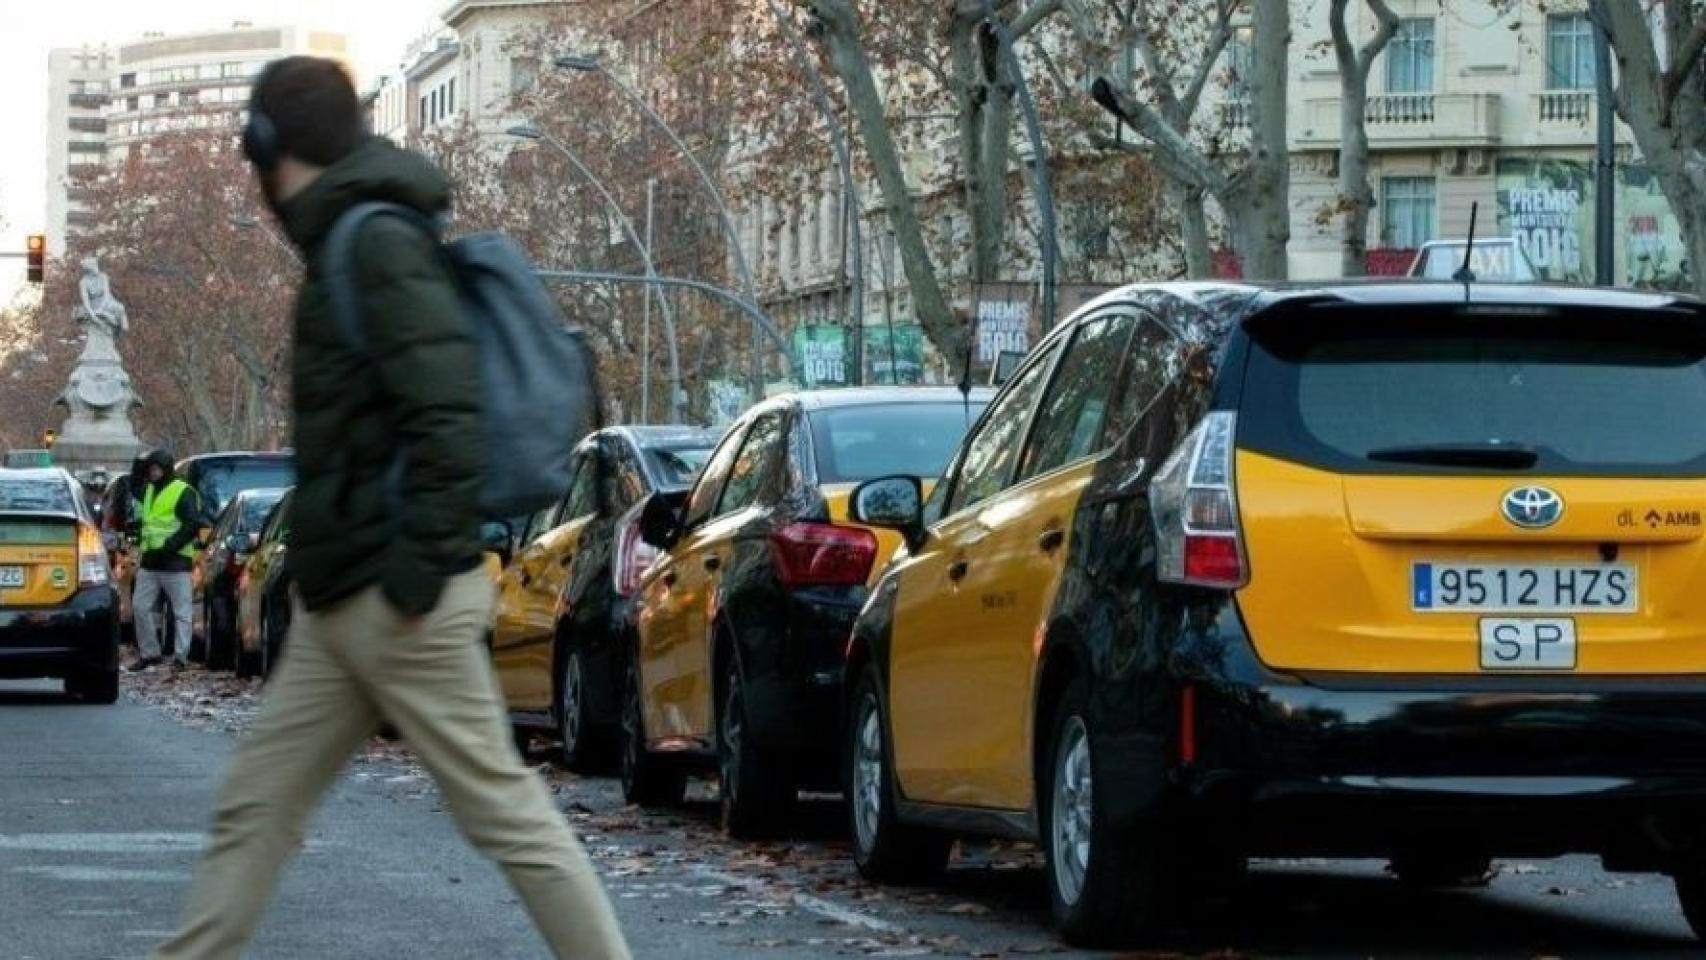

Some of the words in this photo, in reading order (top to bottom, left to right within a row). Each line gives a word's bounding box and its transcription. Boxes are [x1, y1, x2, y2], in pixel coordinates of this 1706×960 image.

[1510, 187, 1578, 213] PREMIS
[1457, 246, 1511, 276] TAXI
[979, 301, 1031, 320] PREMIS
[1665, 510, 1701, 526] AMB
[1440, 569, 1539, 605] 9512
[1554, 569, 1627, 605] HZS
[1493, 625, 1562, 661] SP
